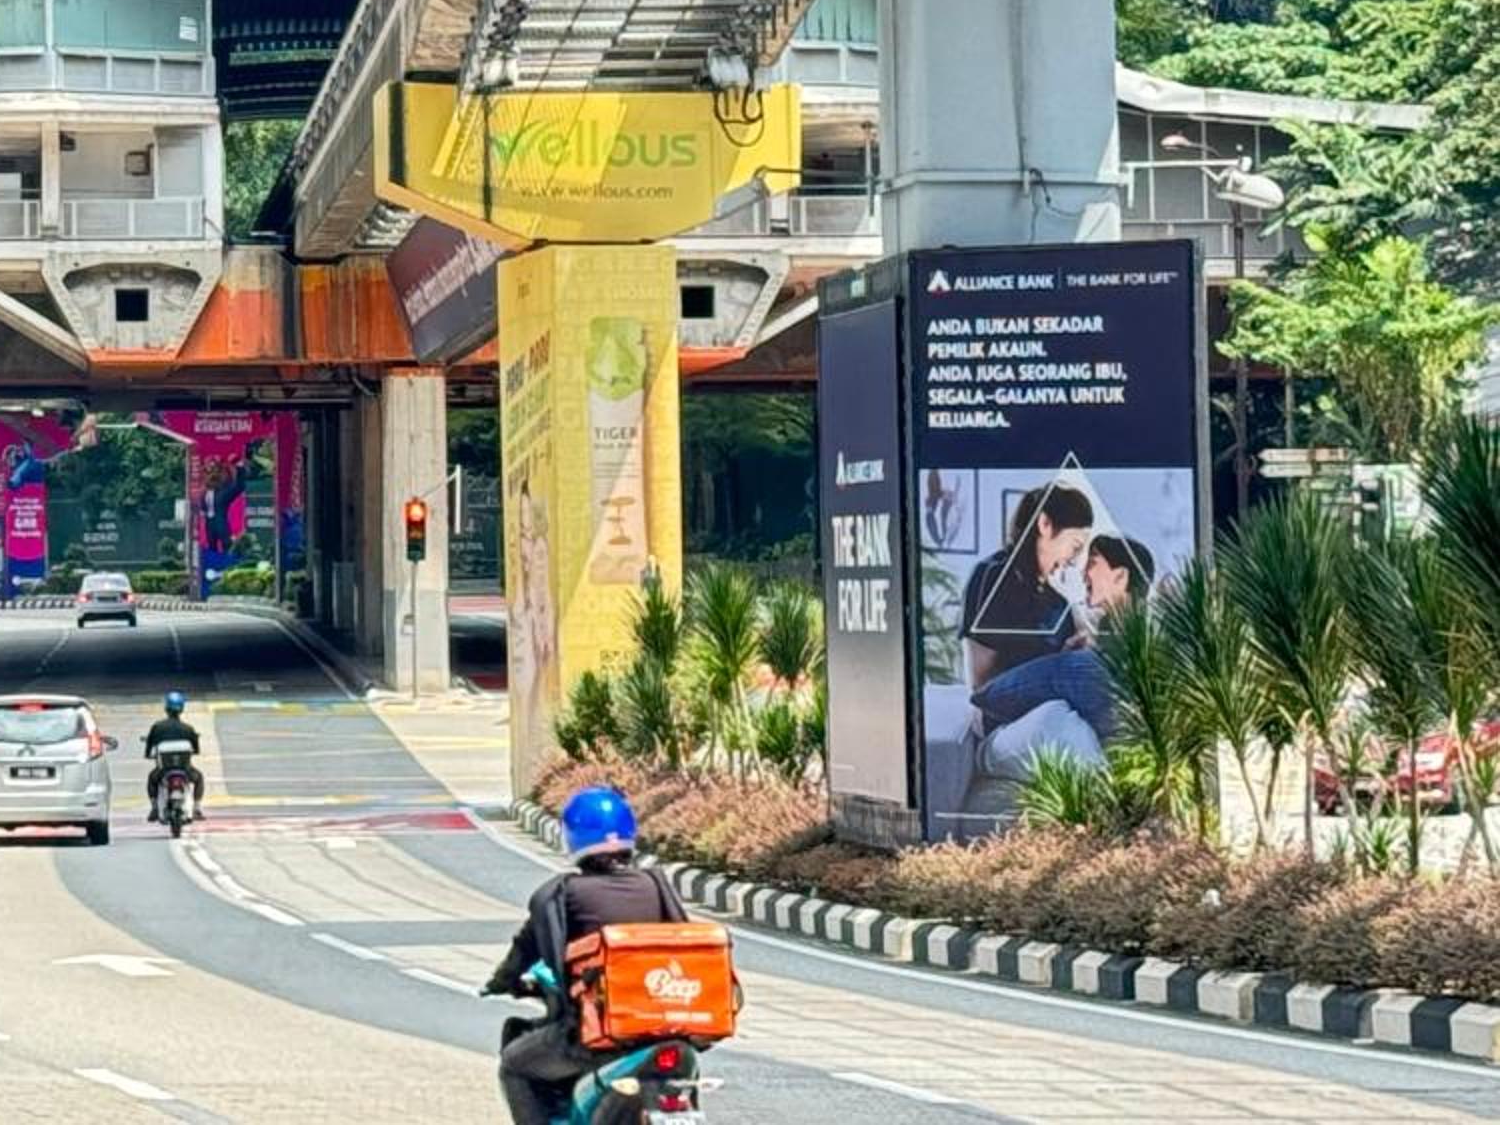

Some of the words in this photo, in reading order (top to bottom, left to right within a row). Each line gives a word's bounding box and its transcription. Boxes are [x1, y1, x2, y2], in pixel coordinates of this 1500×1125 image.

[954, 275, 1015, 291] ALLIANCE
[1018, 273, 1054, 289] BANK
[1066, 274, 1087, 287] THE
[1090, 273, 1121, 286] BANK
[1124, 272, 1146, 286] FOR
[927, 319, 972, 336] ANDA
[975, 317, 1031, 335] BUKAN
[1033, 315, 1104, 334] SEKADAR
[927, 342, 985, 359] PEMILIK
[988, 341, 1047, 358] AKAUN.
[927, 365, 973, 382] ANDA
[975, 364, 1015, 383] JUGA
[1018, 363, 1091, 381] SEORANG
[1095, 362, 1128, 382] IBU,
[1070, 386, 1125, 404] UNTUK
[927, 411, 1011, 429] KELUARGA.
[832, 515, 855, 568] THE
[855, 513, 891, 568] BANK
[837, 579, 863, 632] FOR
[863, 578, 890, 632] LIFE
